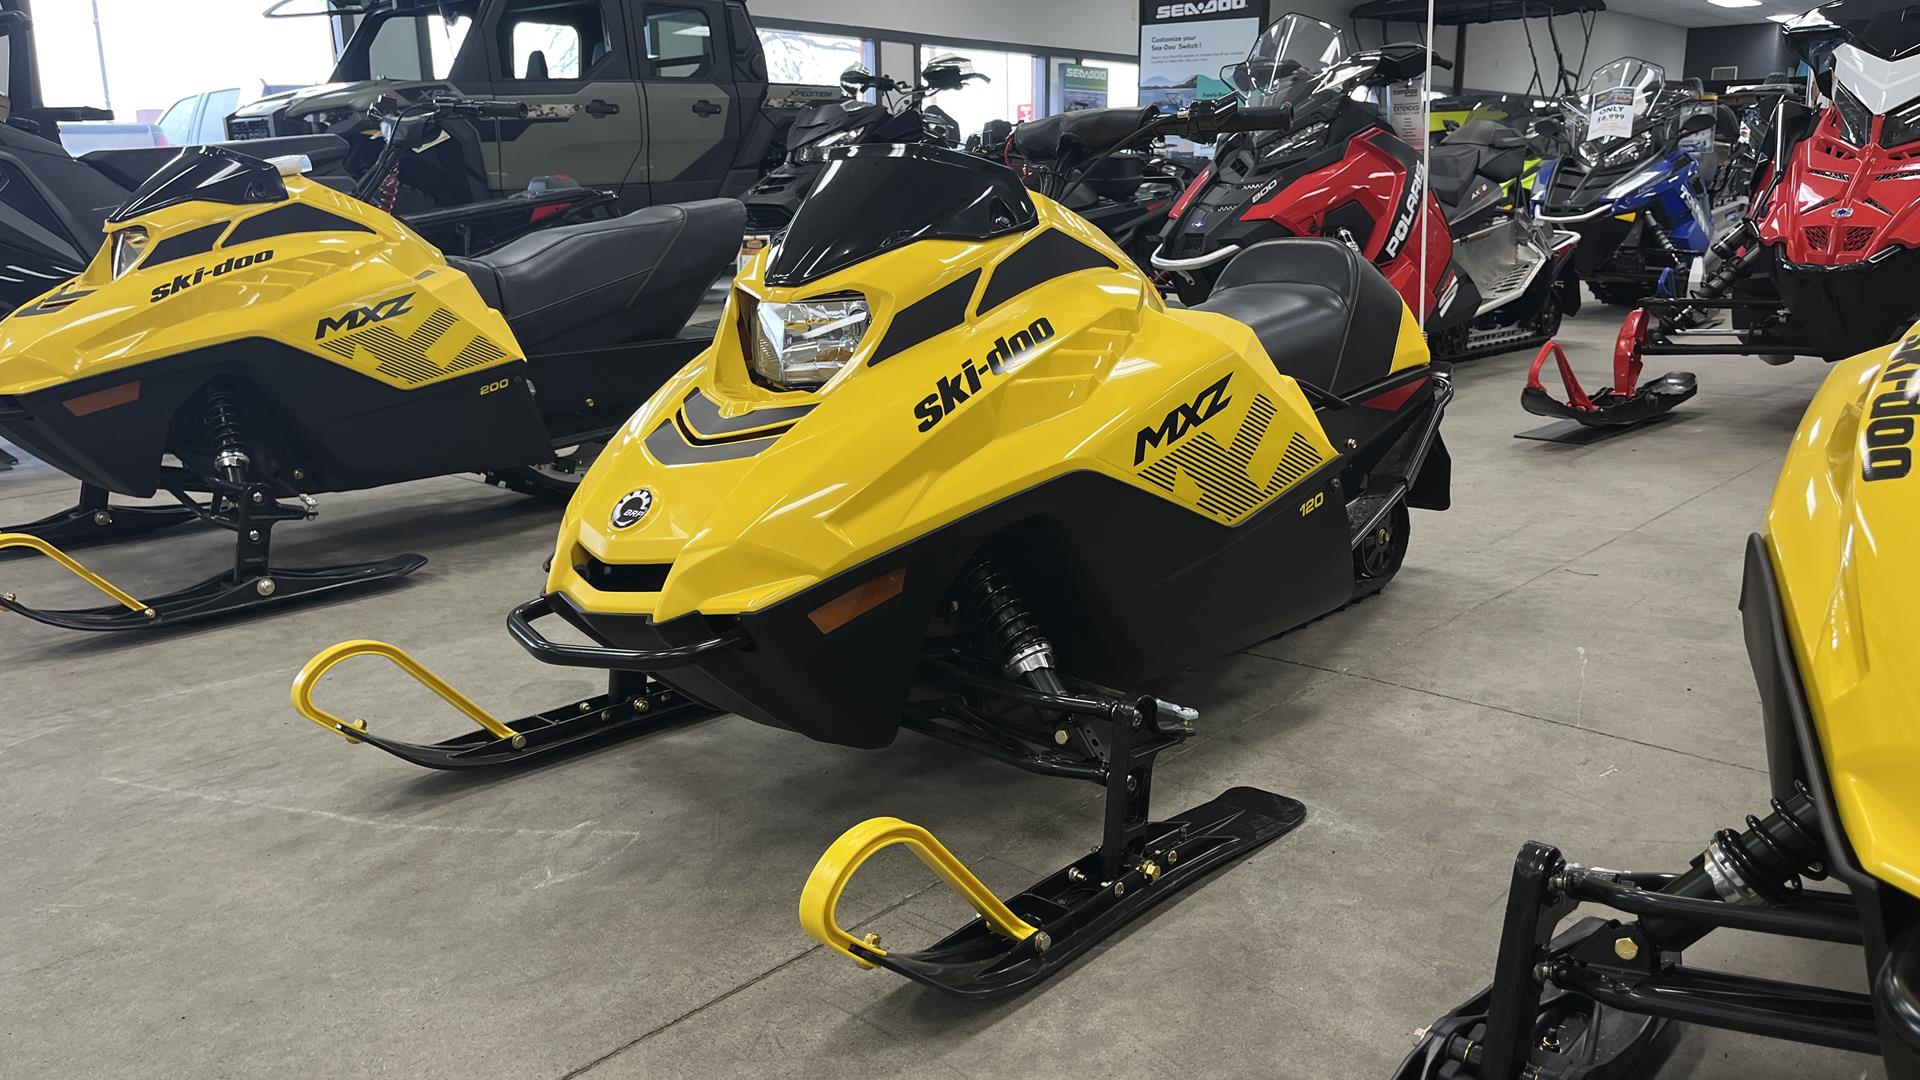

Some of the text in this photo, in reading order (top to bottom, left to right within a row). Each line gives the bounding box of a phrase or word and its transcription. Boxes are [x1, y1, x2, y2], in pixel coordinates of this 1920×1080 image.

[1183, 35, 1197, 43] your
[788, 88, 832, 97] XPEDITION
[1599, 106, 1625, 115] ONLY
[1385, 159, 1425, 258] POLARIS
[150, 250, 274, 303] ski-doo
[315, 291, 417, 341] MXZ
[480, 378, 509, 396] 200
[914, 317, 1055, 433] ski-doo
[1134, 371, 1234, 467] MXZ
[623, 508, 645, 519] BRP
[1299, 491, 1324, 517] 120
